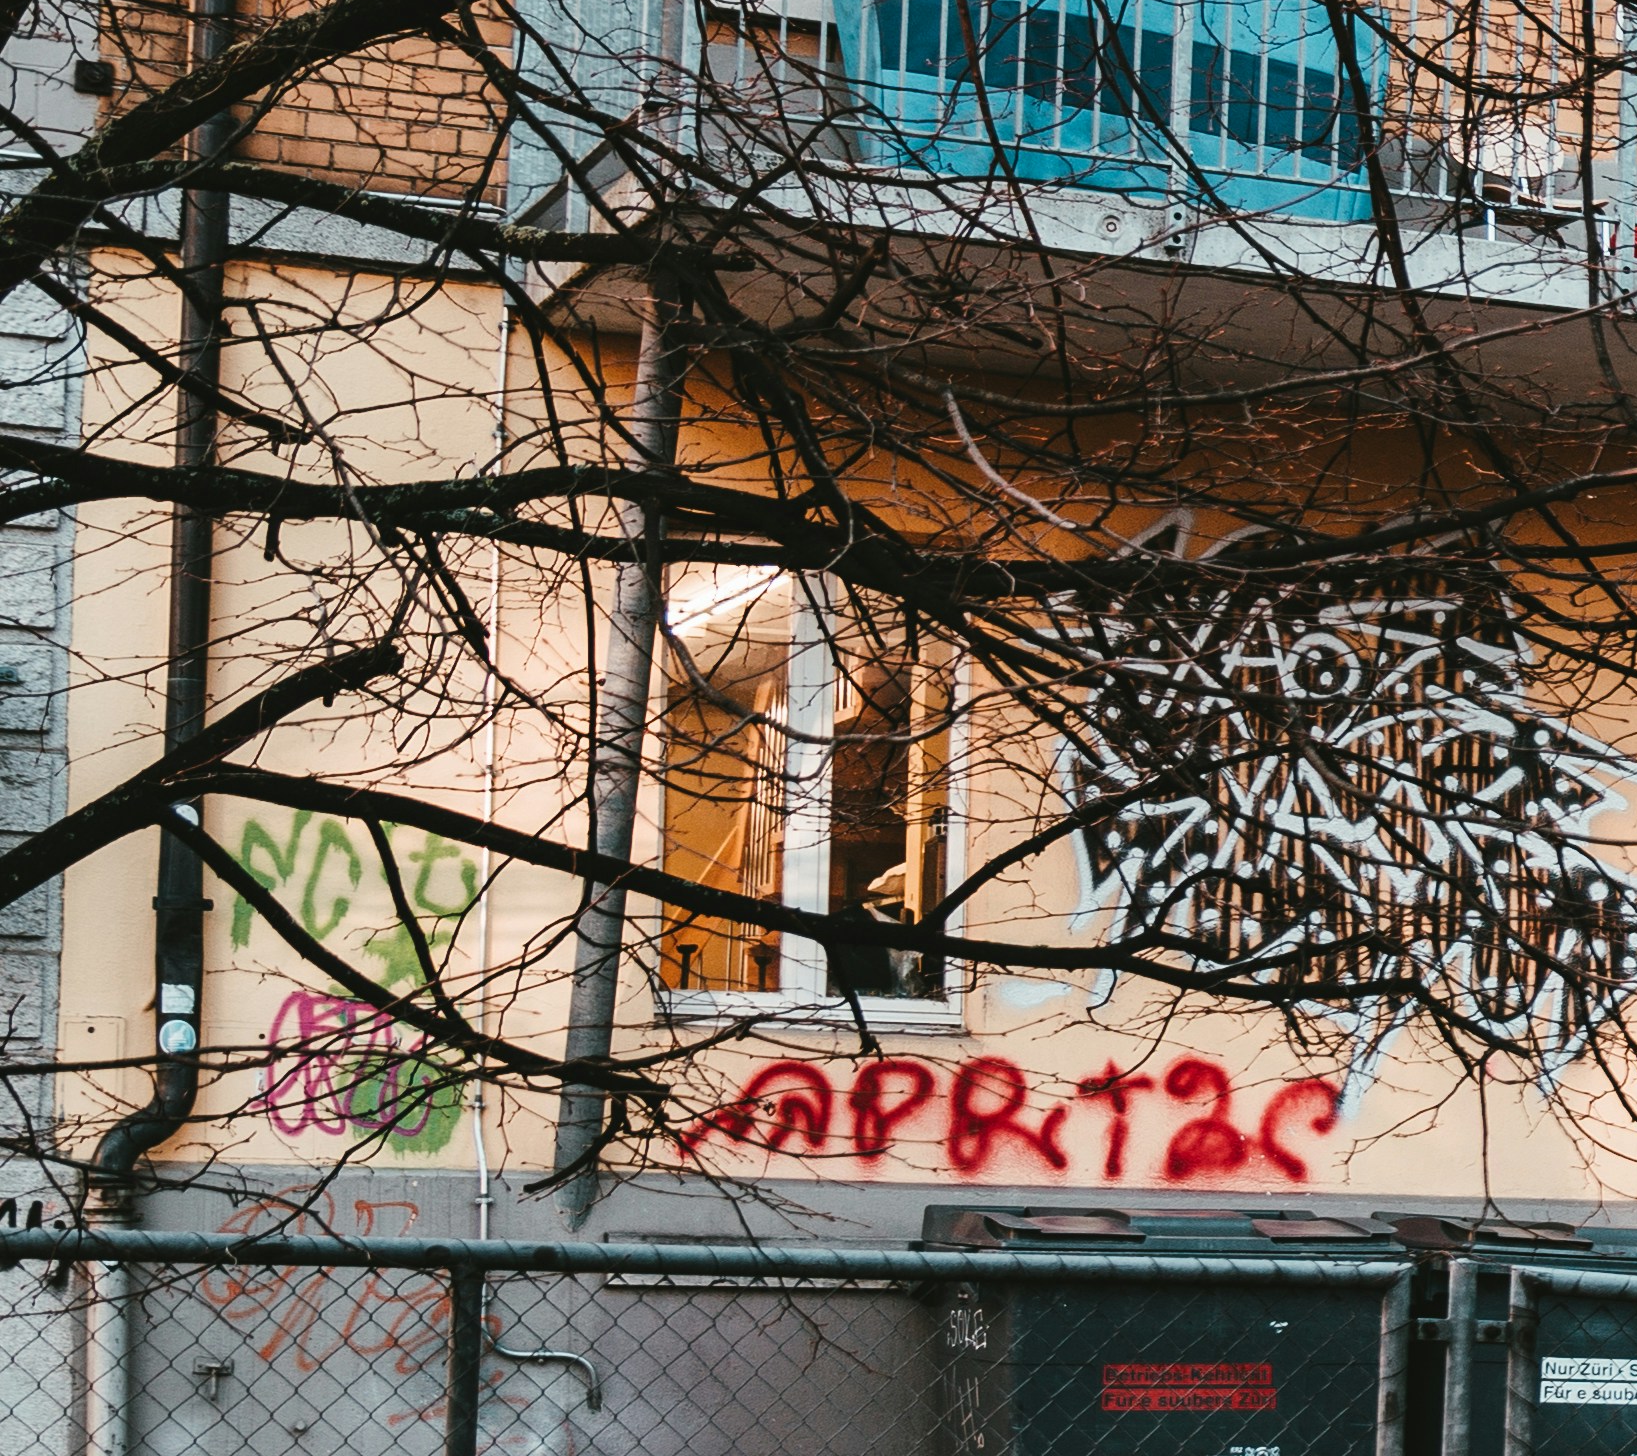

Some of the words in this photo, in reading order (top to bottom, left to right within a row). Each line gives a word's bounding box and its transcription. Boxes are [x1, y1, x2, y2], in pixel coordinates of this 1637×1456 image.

[1545, 1362, 1575, 1376] Nur
[1580, 1362, 1614, 1377] Züri
[1543, 1385, 1573, 1400] Für
[1577, 1389, 1588, 1400] e
